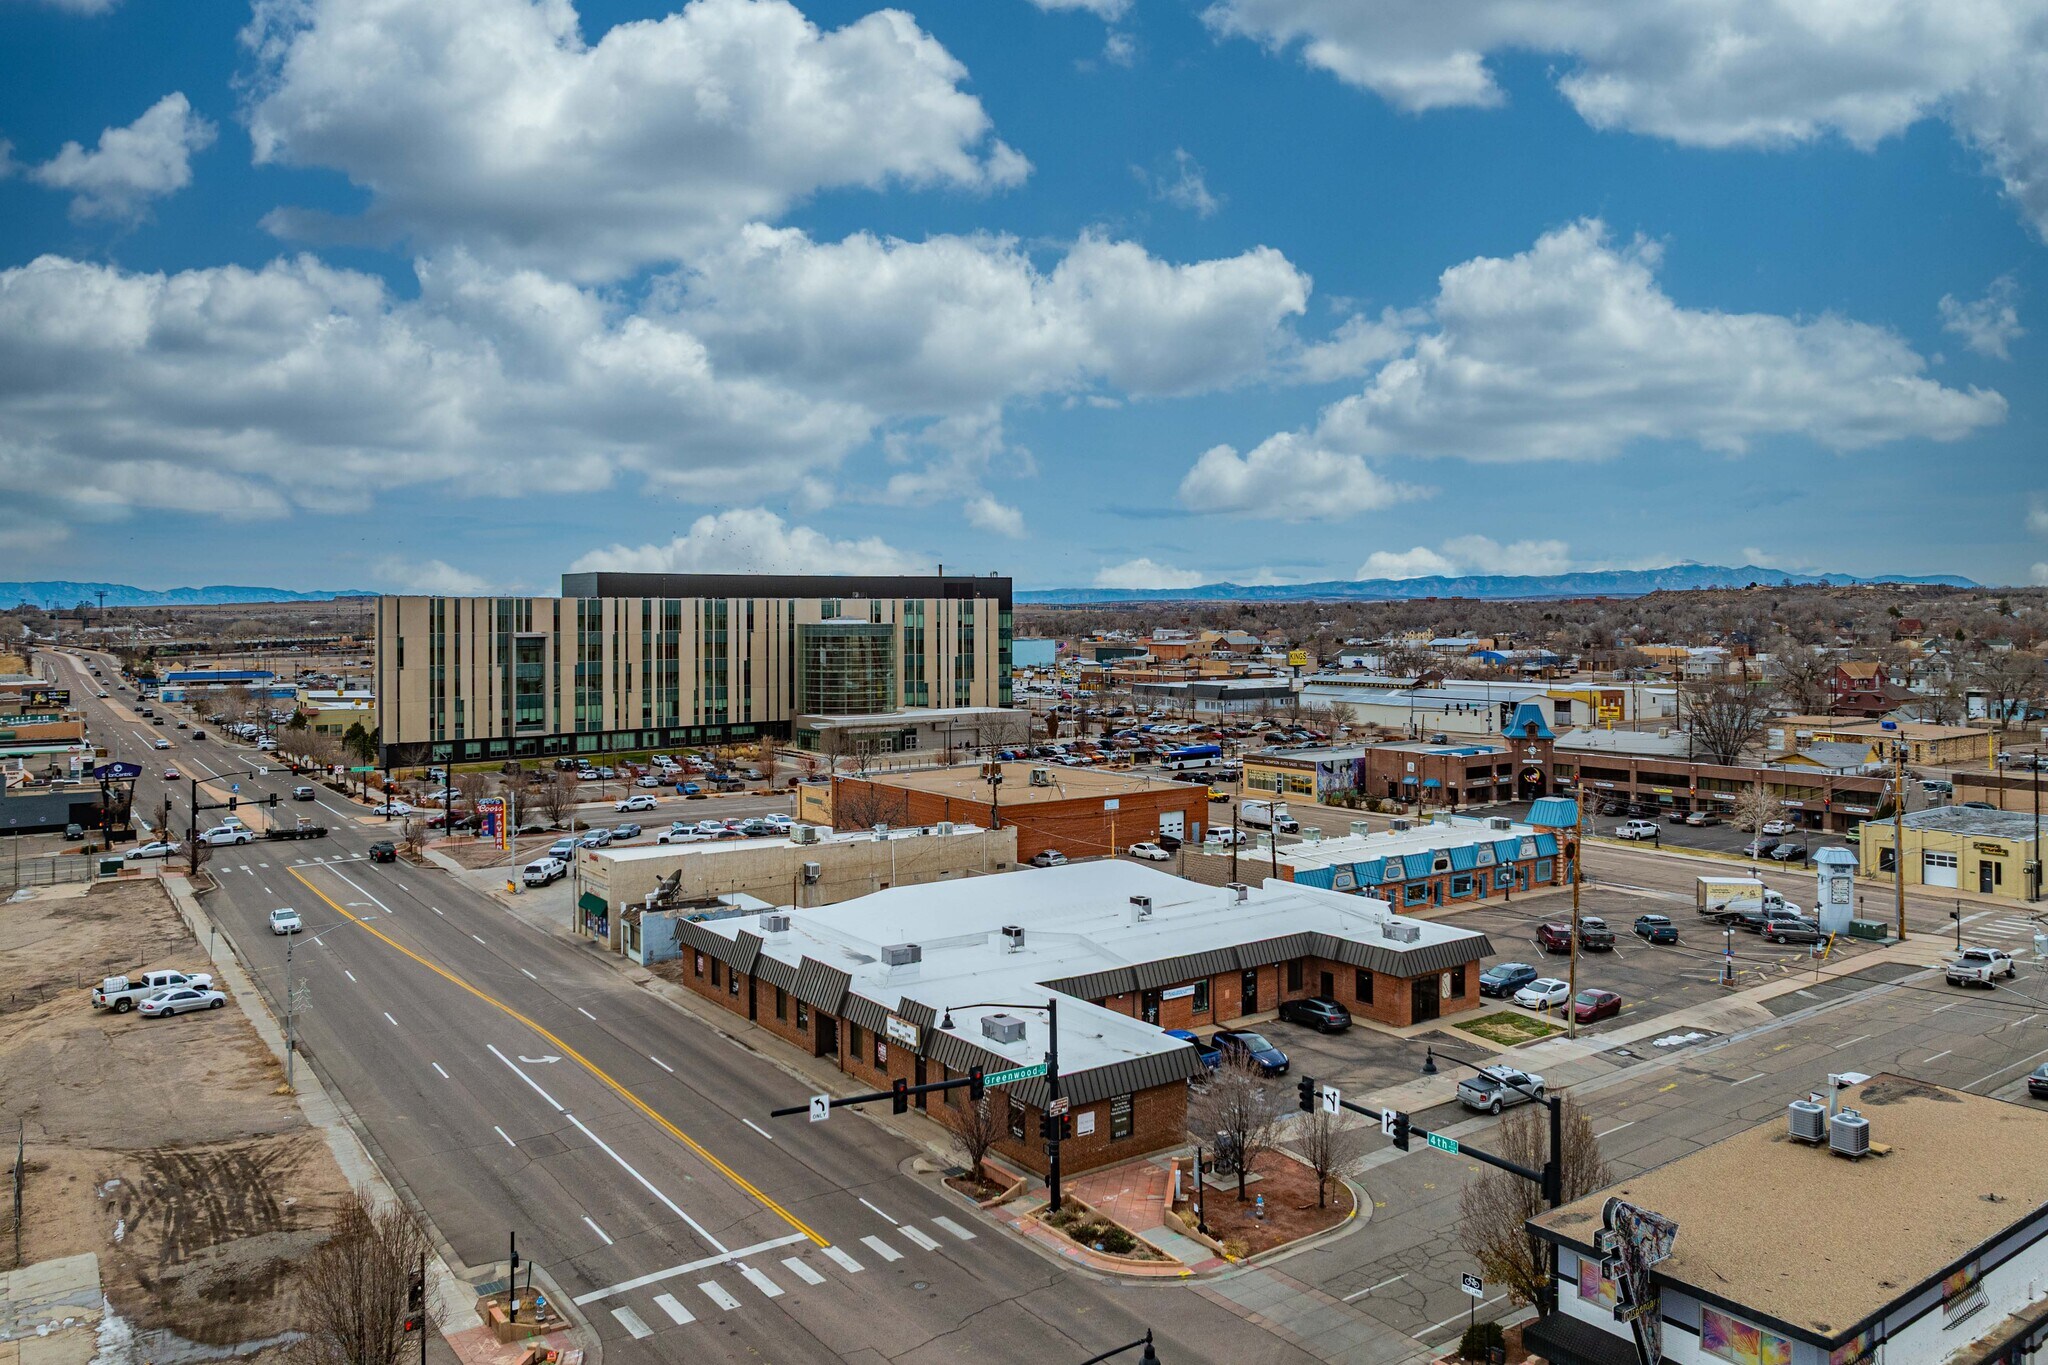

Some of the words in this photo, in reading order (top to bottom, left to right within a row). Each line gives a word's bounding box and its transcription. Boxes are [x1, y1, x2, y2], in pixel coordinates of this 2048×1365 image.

[1290, 652, 1307, 660] KINGS
[477, 804, 503, 812] Coors
[495, 813, 503, 850] TAVERN
[984, 1066, 1038, 1085] Greenwood
[1430, 1135, 1447, 1149] 4th
